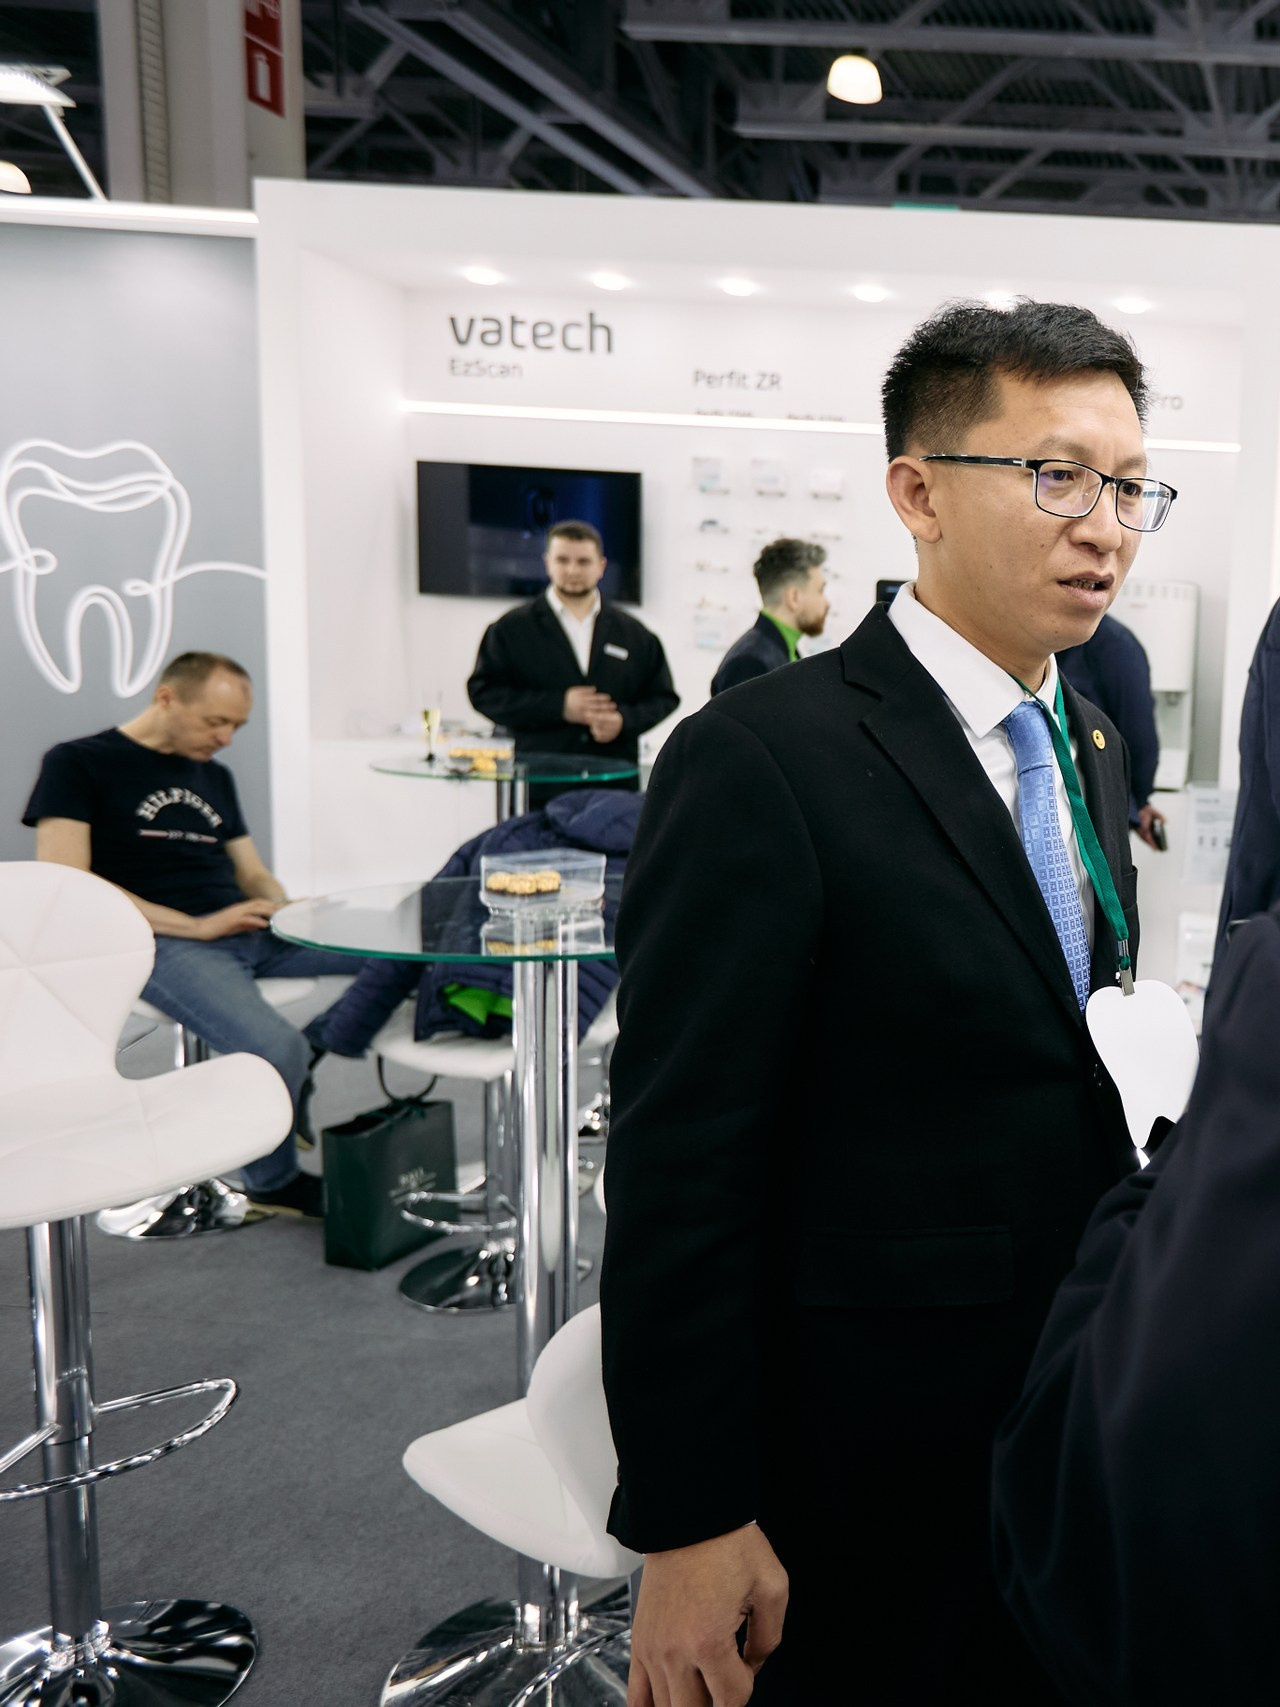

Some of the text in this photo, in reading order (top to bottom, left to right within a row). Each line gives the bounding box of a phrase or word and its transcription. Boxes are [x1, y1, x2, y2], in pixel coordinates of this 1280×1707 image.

[449, 311, 613, 354] vatech
[450, 358, 523, 378] EzScan
[694, 369, 781, 391] Perfit ZR
